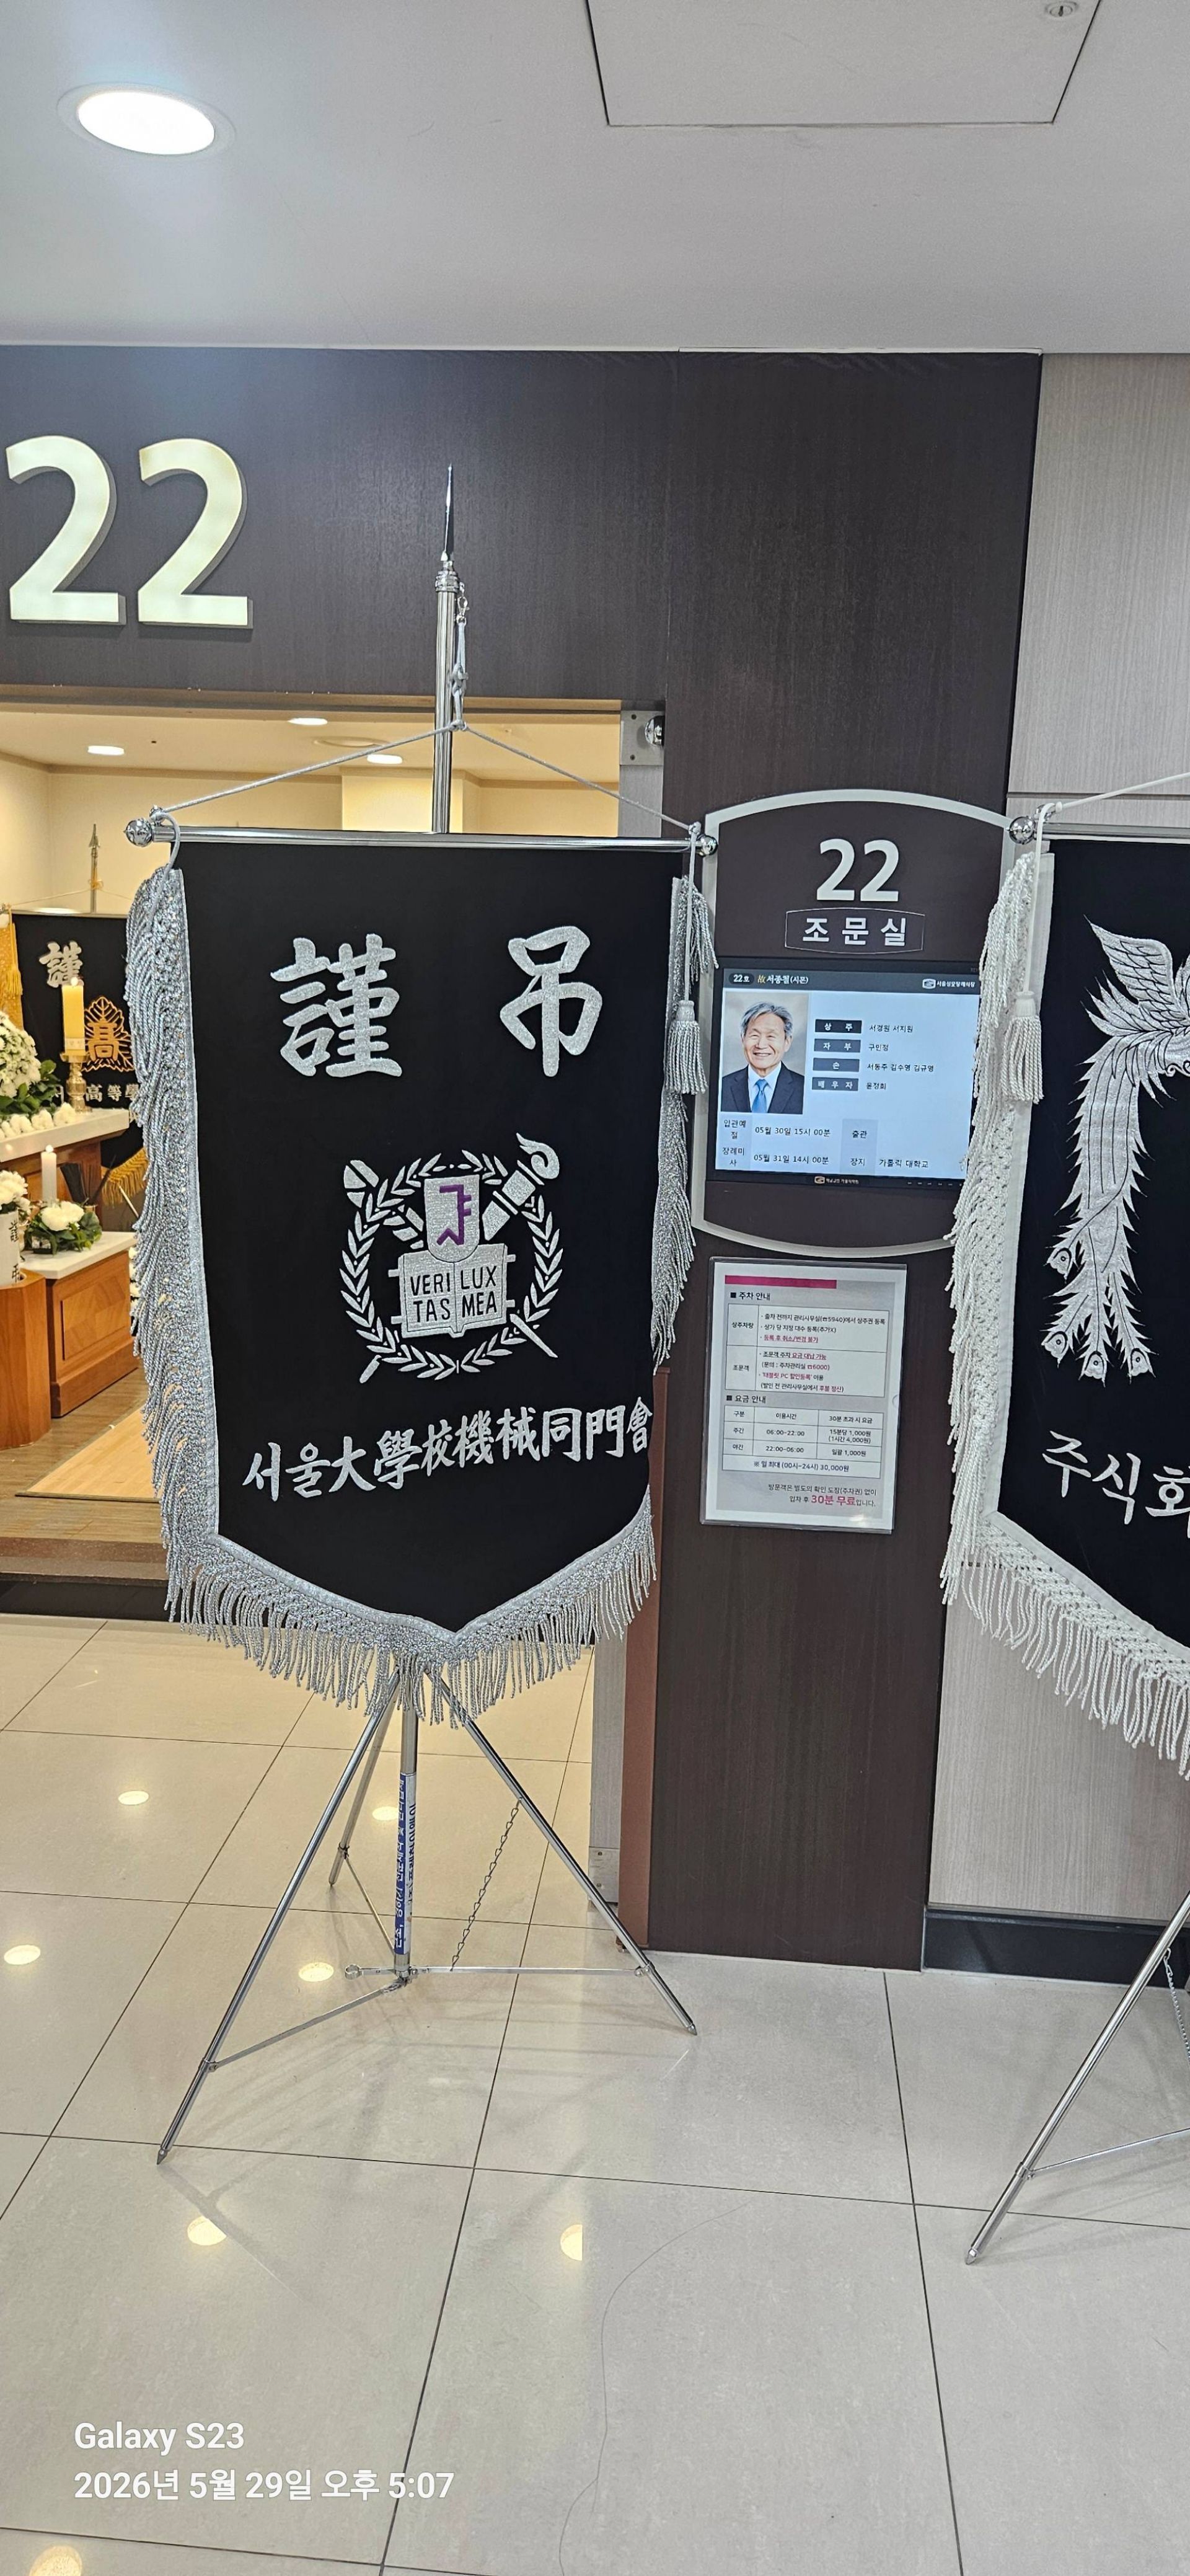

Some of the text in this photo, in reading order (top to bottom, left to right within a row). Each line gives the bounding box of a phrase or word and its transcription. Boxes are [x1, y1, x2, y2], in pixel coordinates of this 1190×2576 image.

[6, 435, 253, 628] 22
[816, 838, 899, 902] 22
[802, 918, 906, 947] 조문실
[733, 974, 750, 983] 22호
[832, 1062, 840, 1070] 손
[818, 1080, 853, 1089] 배우자
[755, 1126, 831, 1137] 05월 30일 15시 00분
[852, 1130, 868, 1139] 출관
[754, 1154, 829, 1165] 05월 31일 14시 00분
[850, 1157, 865, 1166] 장지
[906, 1159, 929, 1168] 대학교
[461, 1266, 497, 1290] LUX
[410, 1273, 451, 1296] VERI
[739, 1292, 770, 1301] 주차 안내
[462, 1291, 497, 1317] MEA
[413, 1299, 451, 1323] TAS
[735, 1395, 766, 1404] 요금 안내
[820, 1464, 849, 1472] 30,000원
[811, 1495, 834, 1505] 30분
